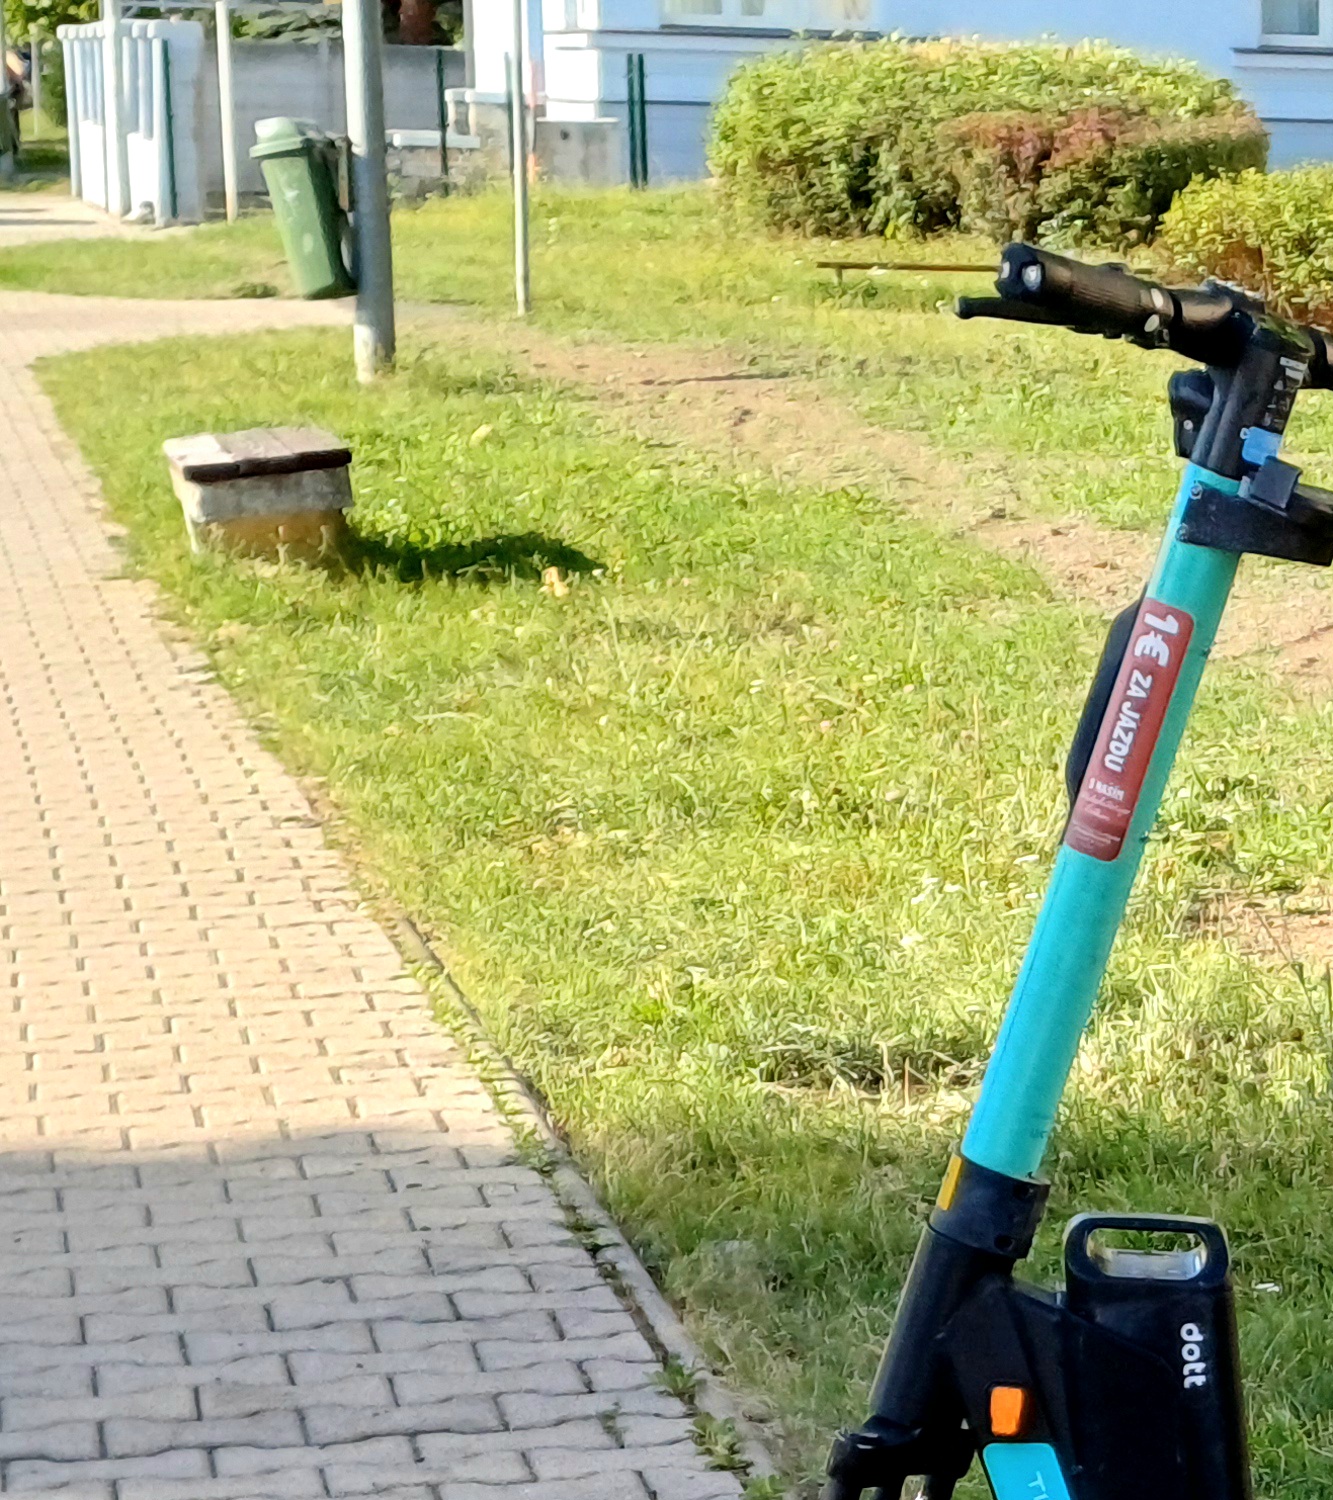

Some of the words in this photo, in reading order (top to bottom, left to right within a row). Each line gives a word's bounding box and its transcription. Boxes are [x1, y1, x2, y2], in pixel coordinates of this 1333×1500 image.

[1134, 611, 1180, 668] 1€
[1126, 669, 1154, 700] ZA
[1103, 700, 1145, 773] JAZDU
[1179, 1322, 1207, 1389] dott
